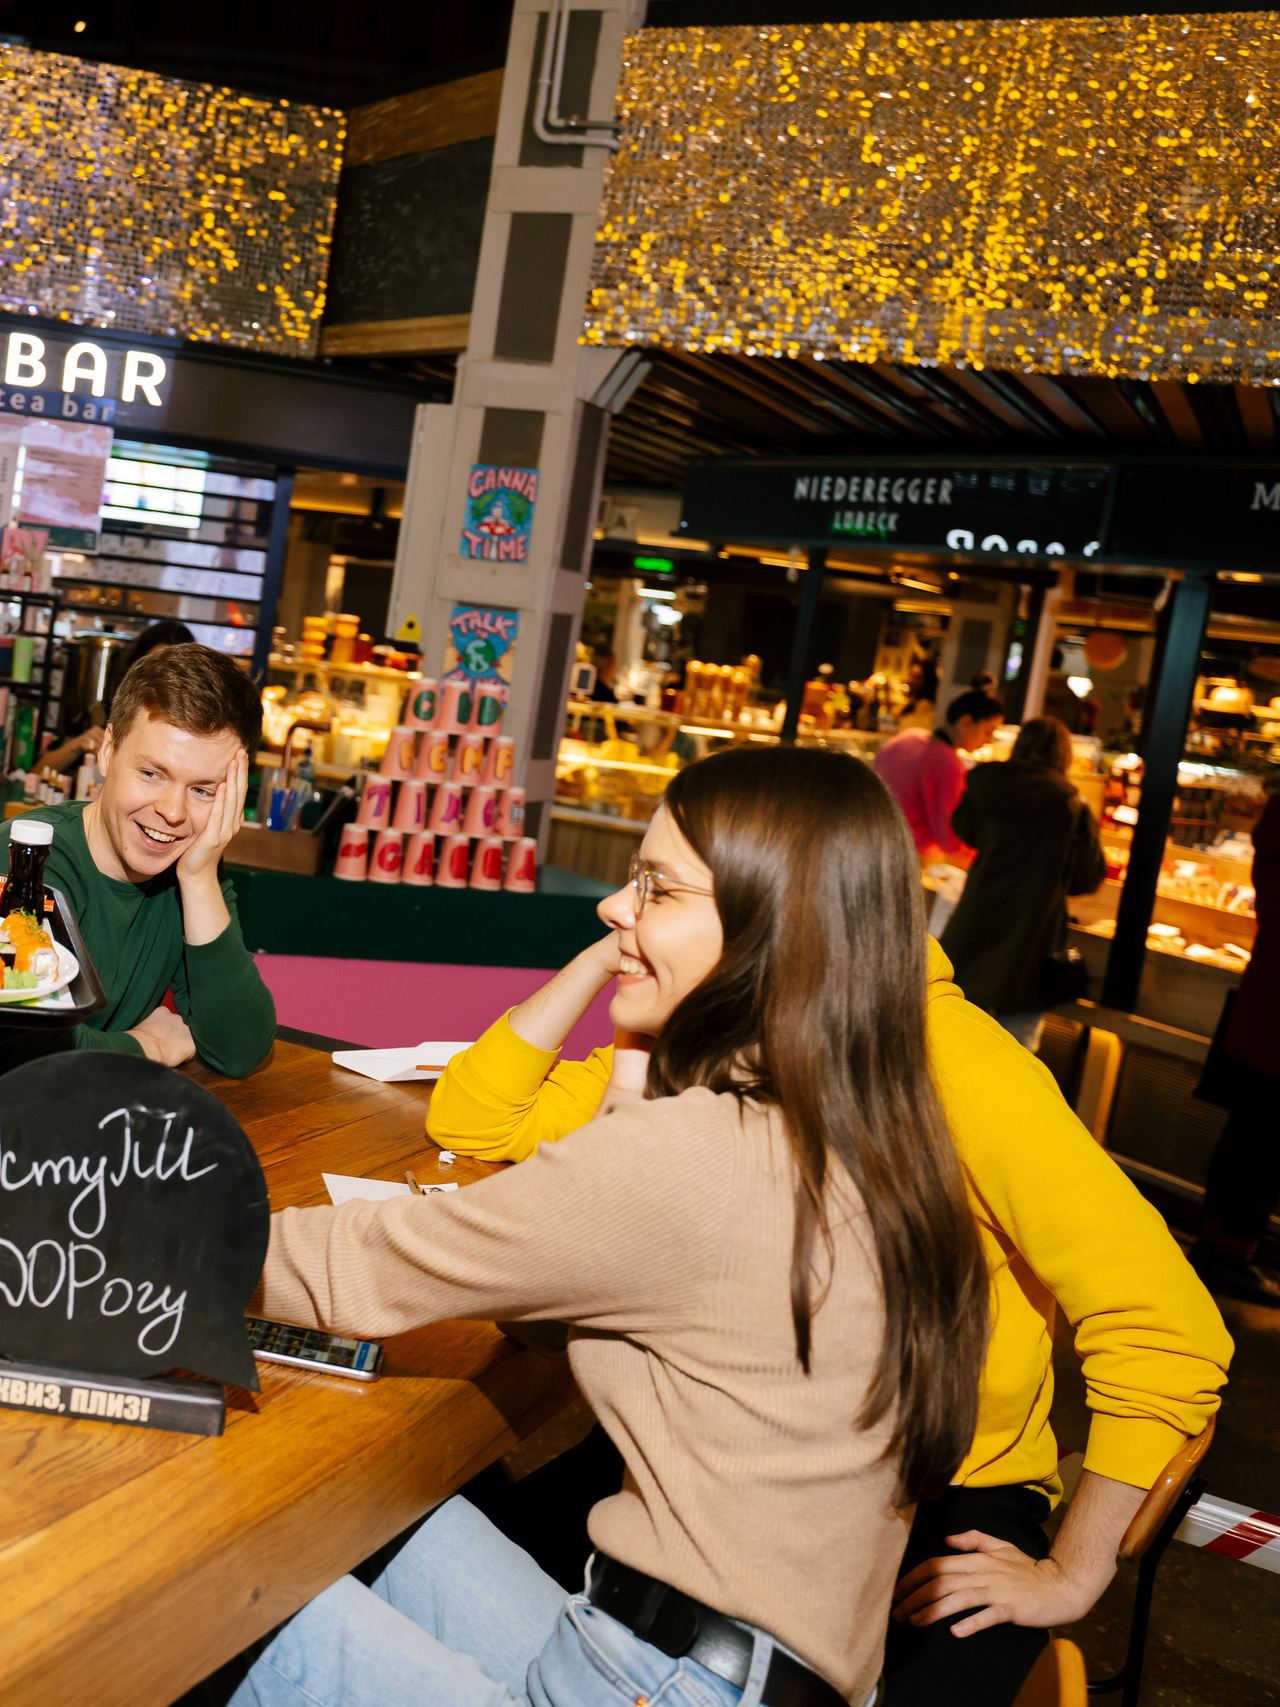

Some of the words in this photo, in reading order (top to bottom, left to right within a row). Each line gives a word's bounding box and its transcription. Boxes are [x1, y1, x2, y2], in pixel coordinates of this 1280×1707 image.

[62, 391, 116, 424] bar
[468, 467, 538, 504] CANNA
[793, 475, 954, 506] NIEDEREGGER
[462, 529, 528, 563] TIME
[450, 610, 516, 641] TALK
[70, 1387, 152, 1423] ПЛИЗ!
